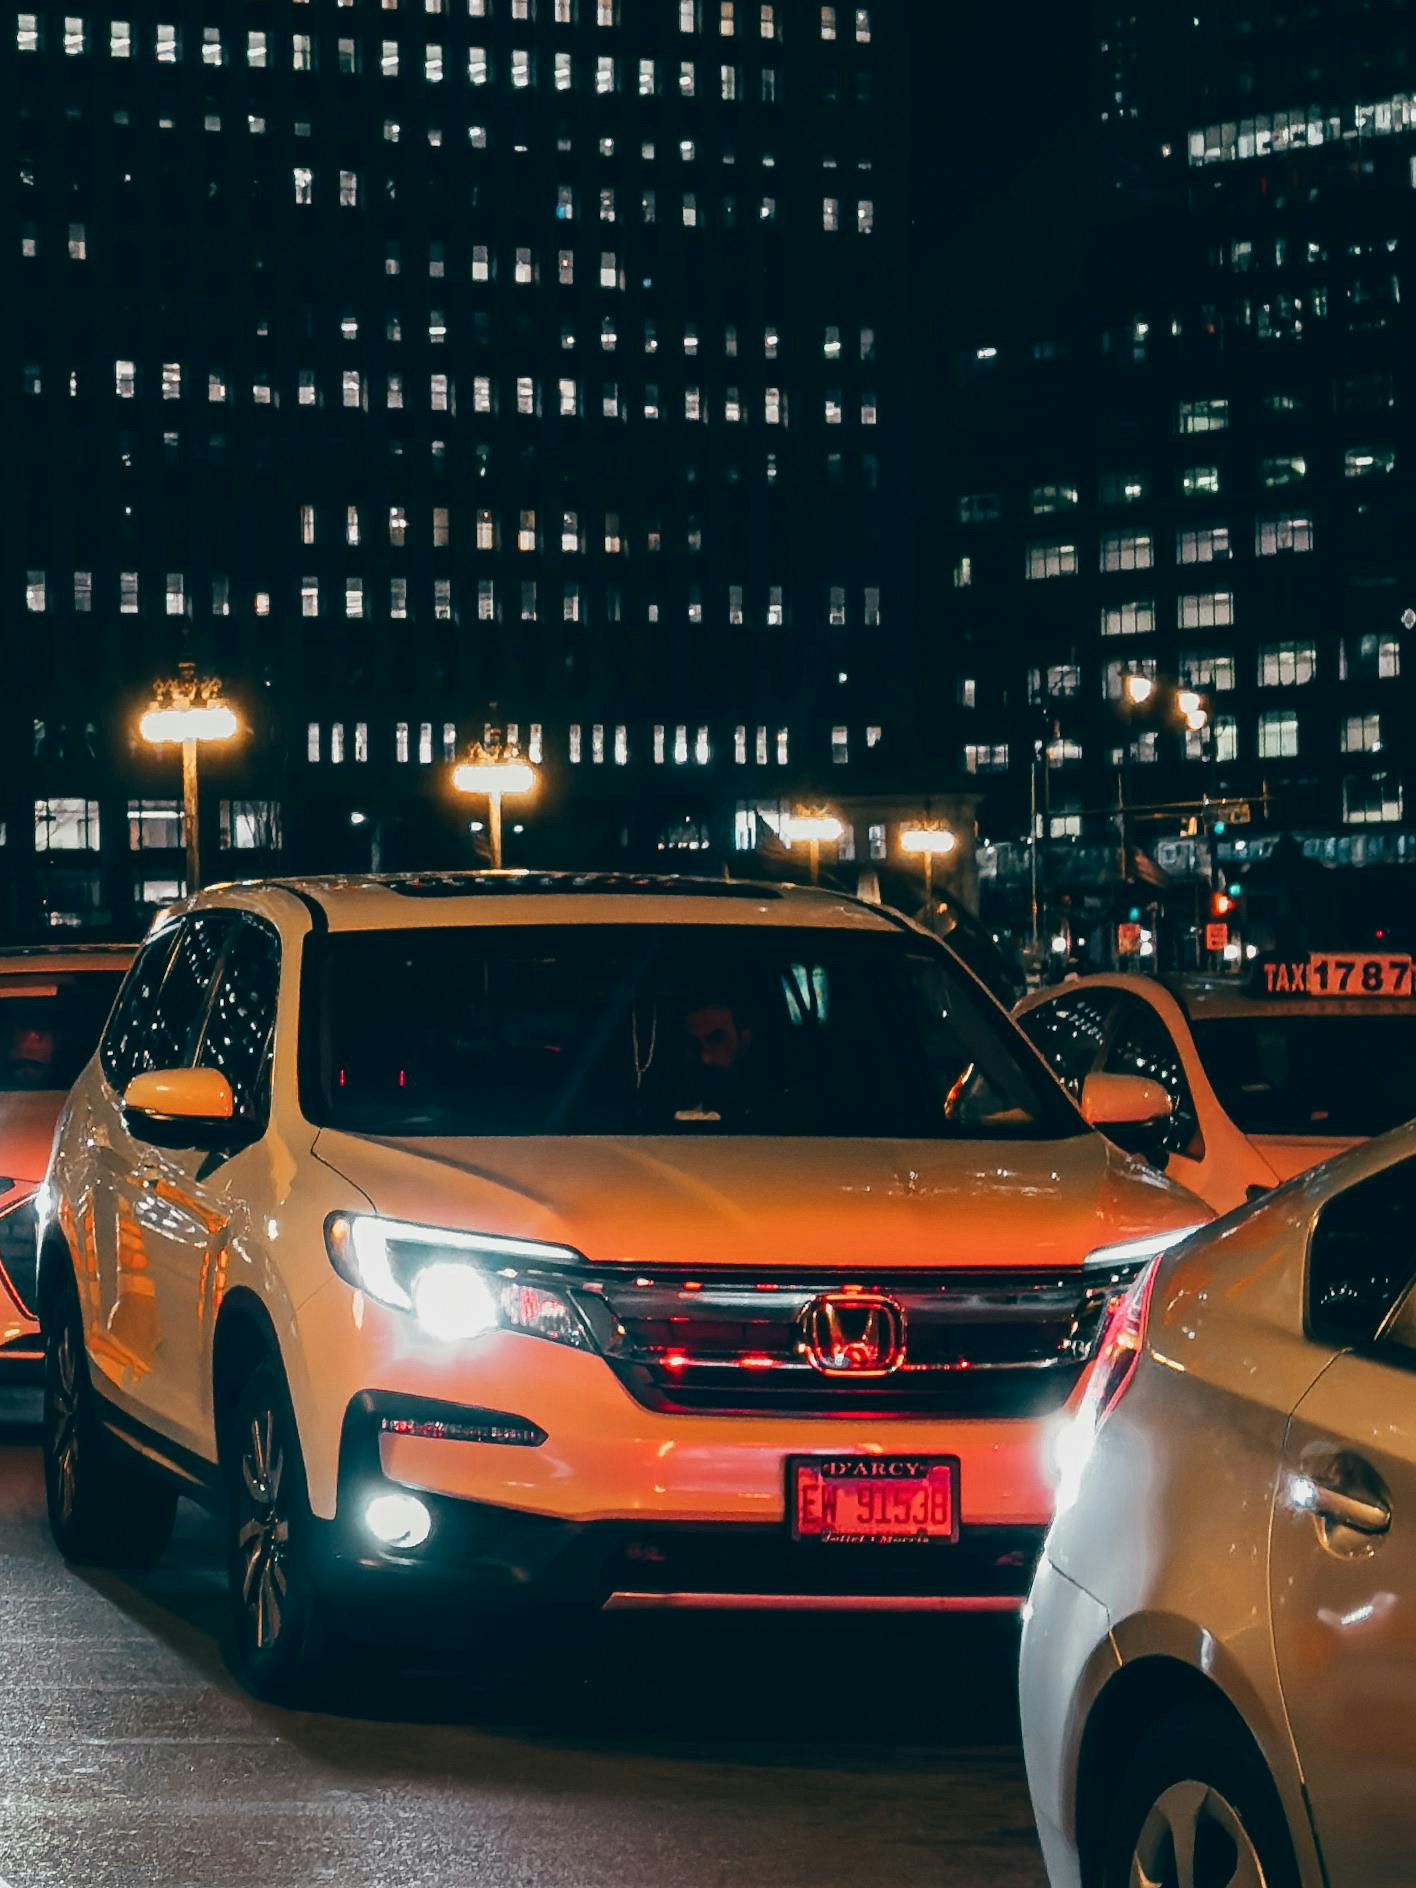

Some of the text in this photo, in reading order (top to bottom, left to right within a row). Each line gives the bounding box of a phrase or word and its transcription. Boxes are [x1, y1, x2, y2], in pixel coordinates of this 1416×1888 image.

[1264, 963, 1311, 992] TAXI
[1314, 960, 1409, 991] 1787
[828, 1462, 920, 1476] D'ARCY
[856, 1485, 948, 1525] 91538
